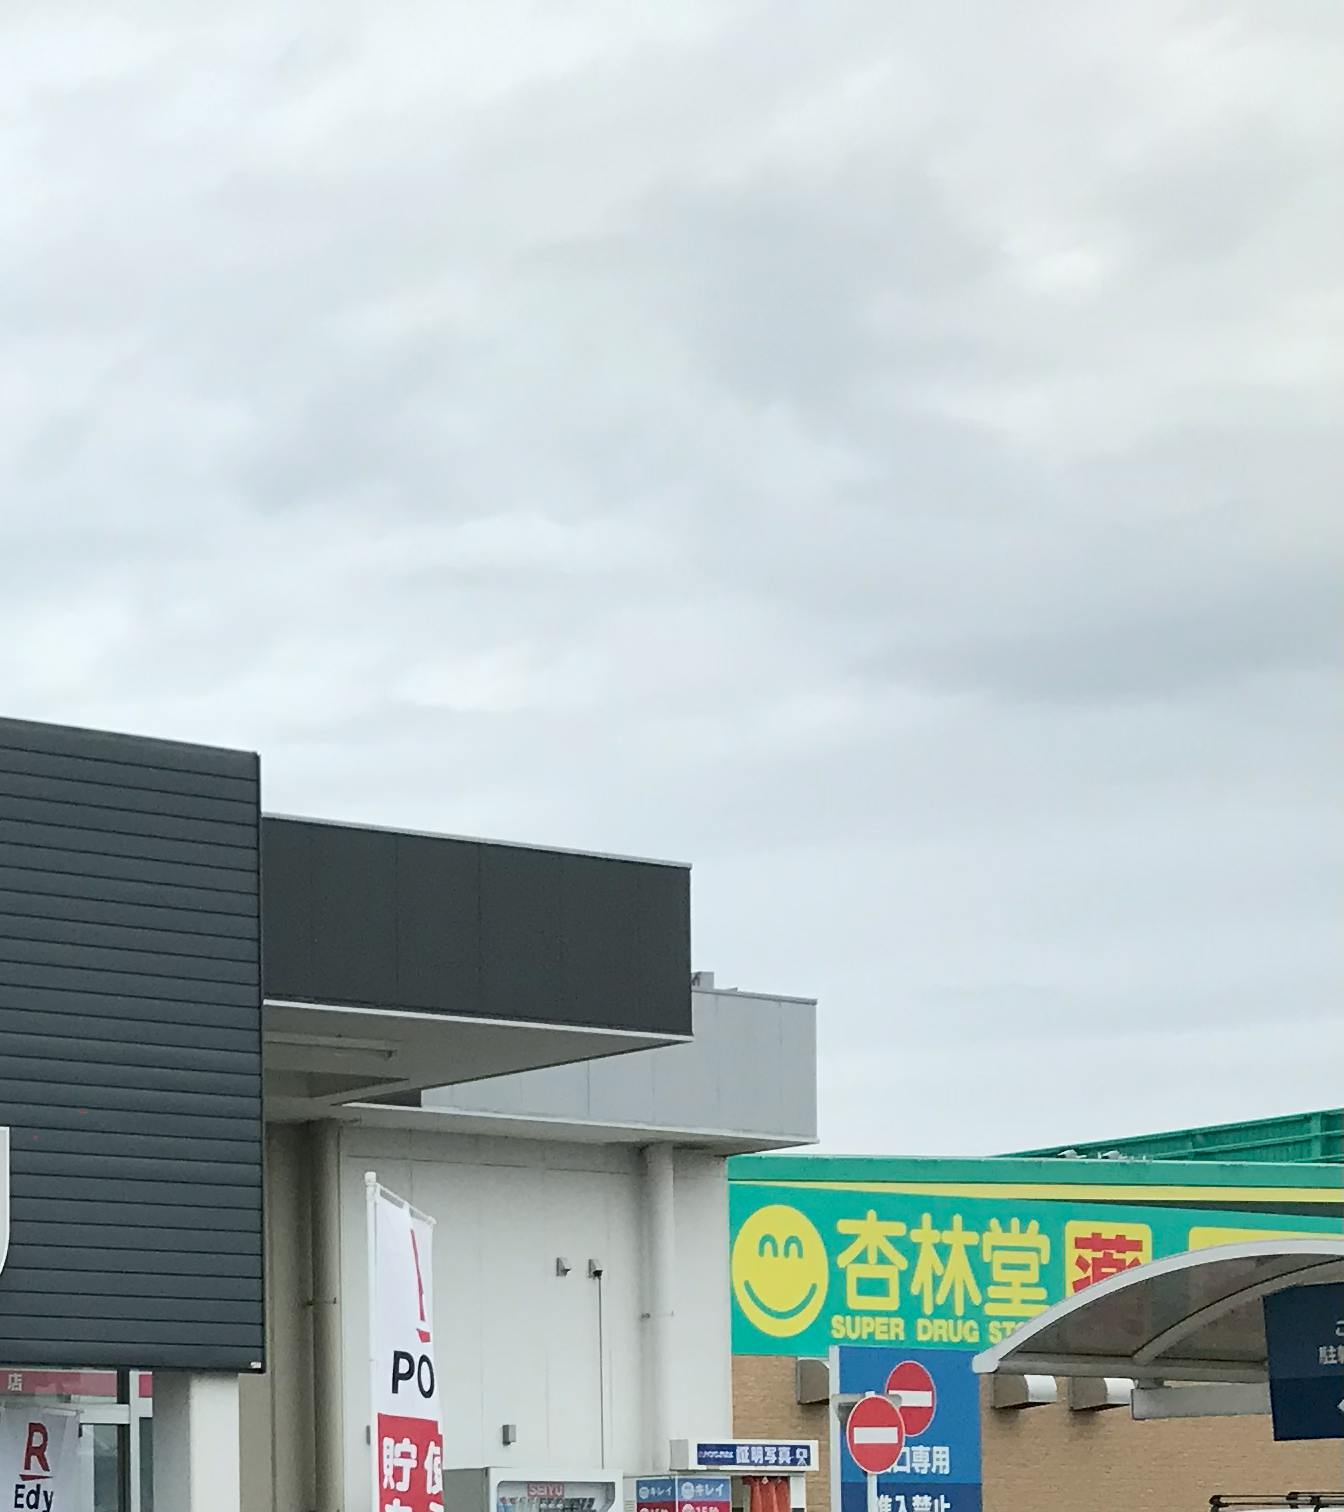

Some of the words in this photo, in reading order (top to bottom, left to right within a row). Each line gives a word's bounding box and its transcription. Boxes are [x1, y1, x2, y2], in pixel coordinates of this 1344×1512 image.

[835, 1208, 1052, 1318] 杏林堂
[830, 1314, 906, 1341] SUPER
[916, 1317, 980, 1343] DRUG
[23, 1421, 51, 1473] R
[735, 1445, 793, 1464] 証明写真
[886, 1445, 951, 1475] 口専用
[528, 1484, 564, 1497] SEIYU
